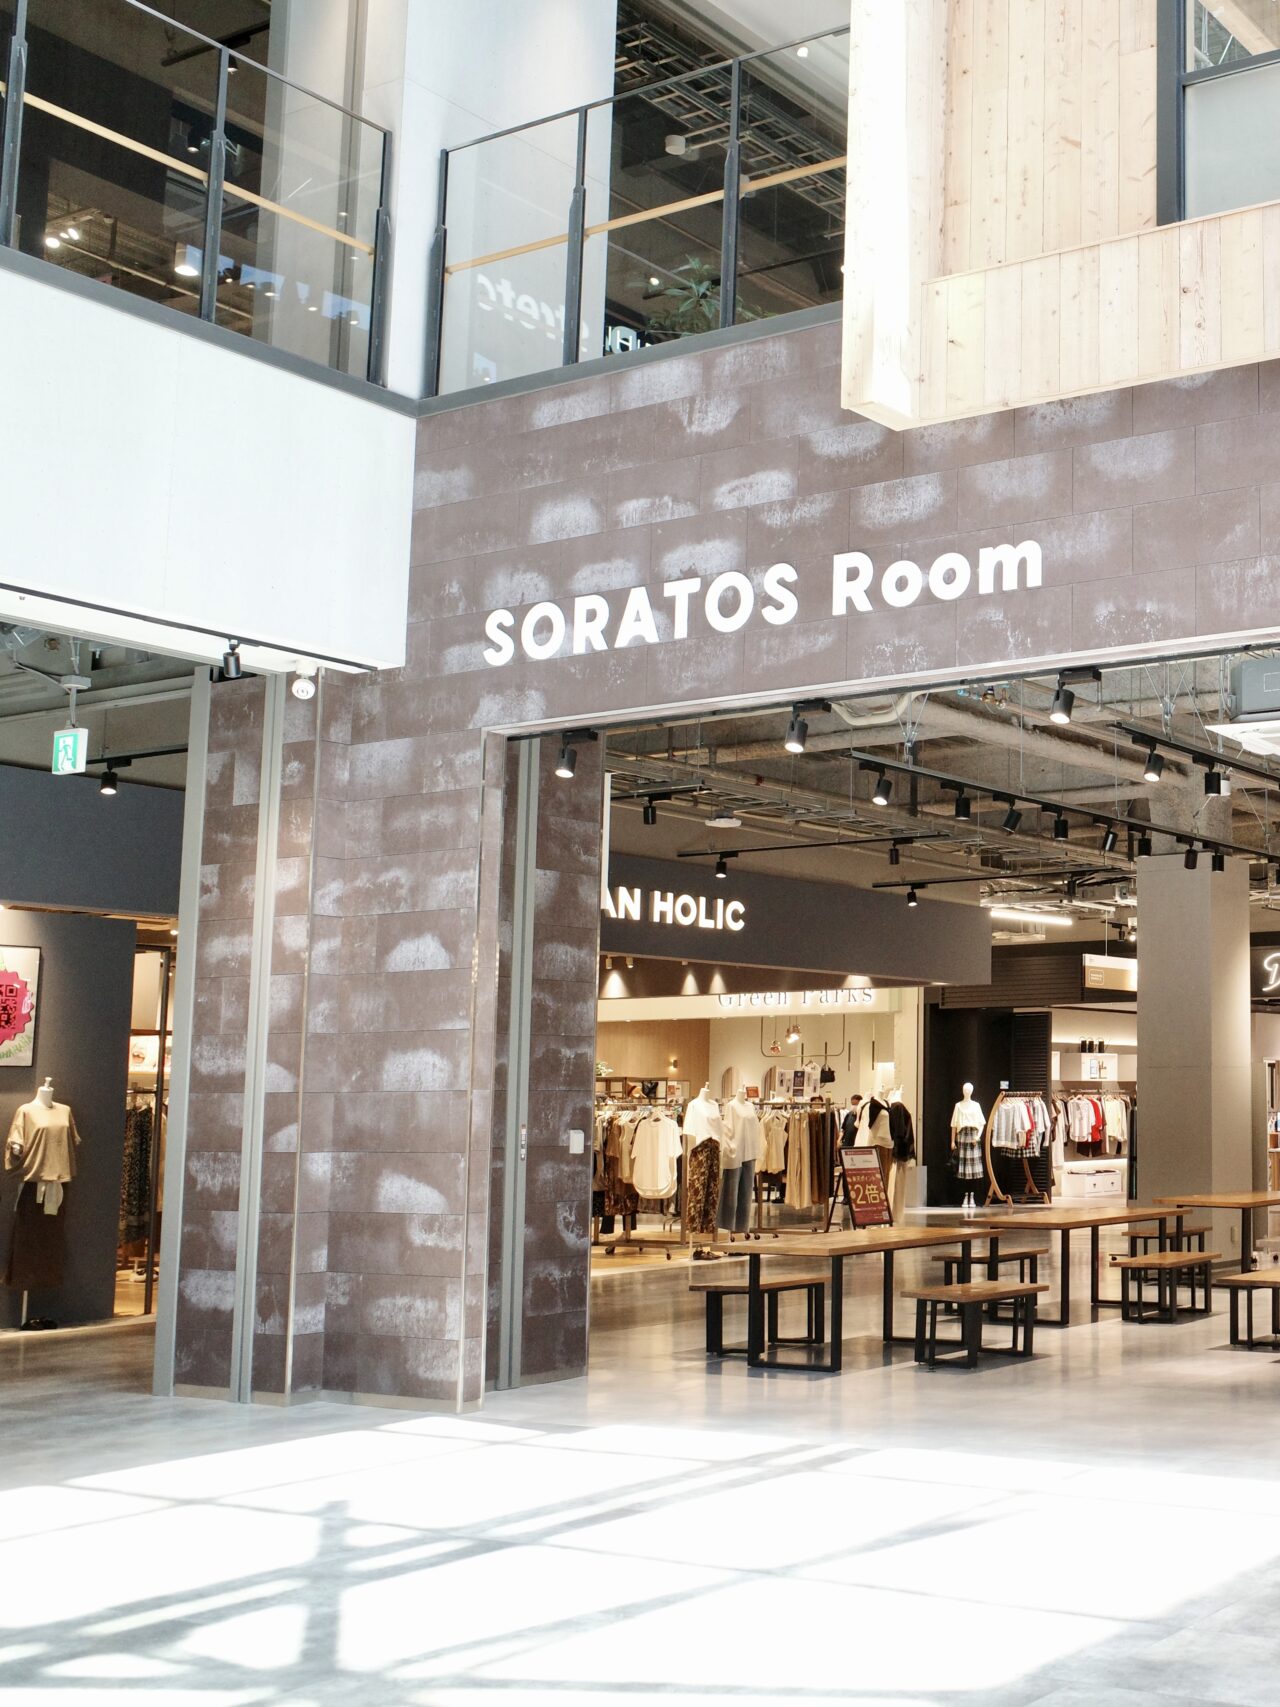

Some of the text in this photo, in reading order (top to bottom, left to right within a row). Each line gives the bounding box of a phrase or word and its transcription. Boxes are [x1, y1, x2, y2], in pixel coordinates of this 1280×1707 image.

[483, 540, 1042, 666] SORATOS Room
[653, 890, 746, 931] HOLIC
[854, 1184, 880, 1204] 2倍
